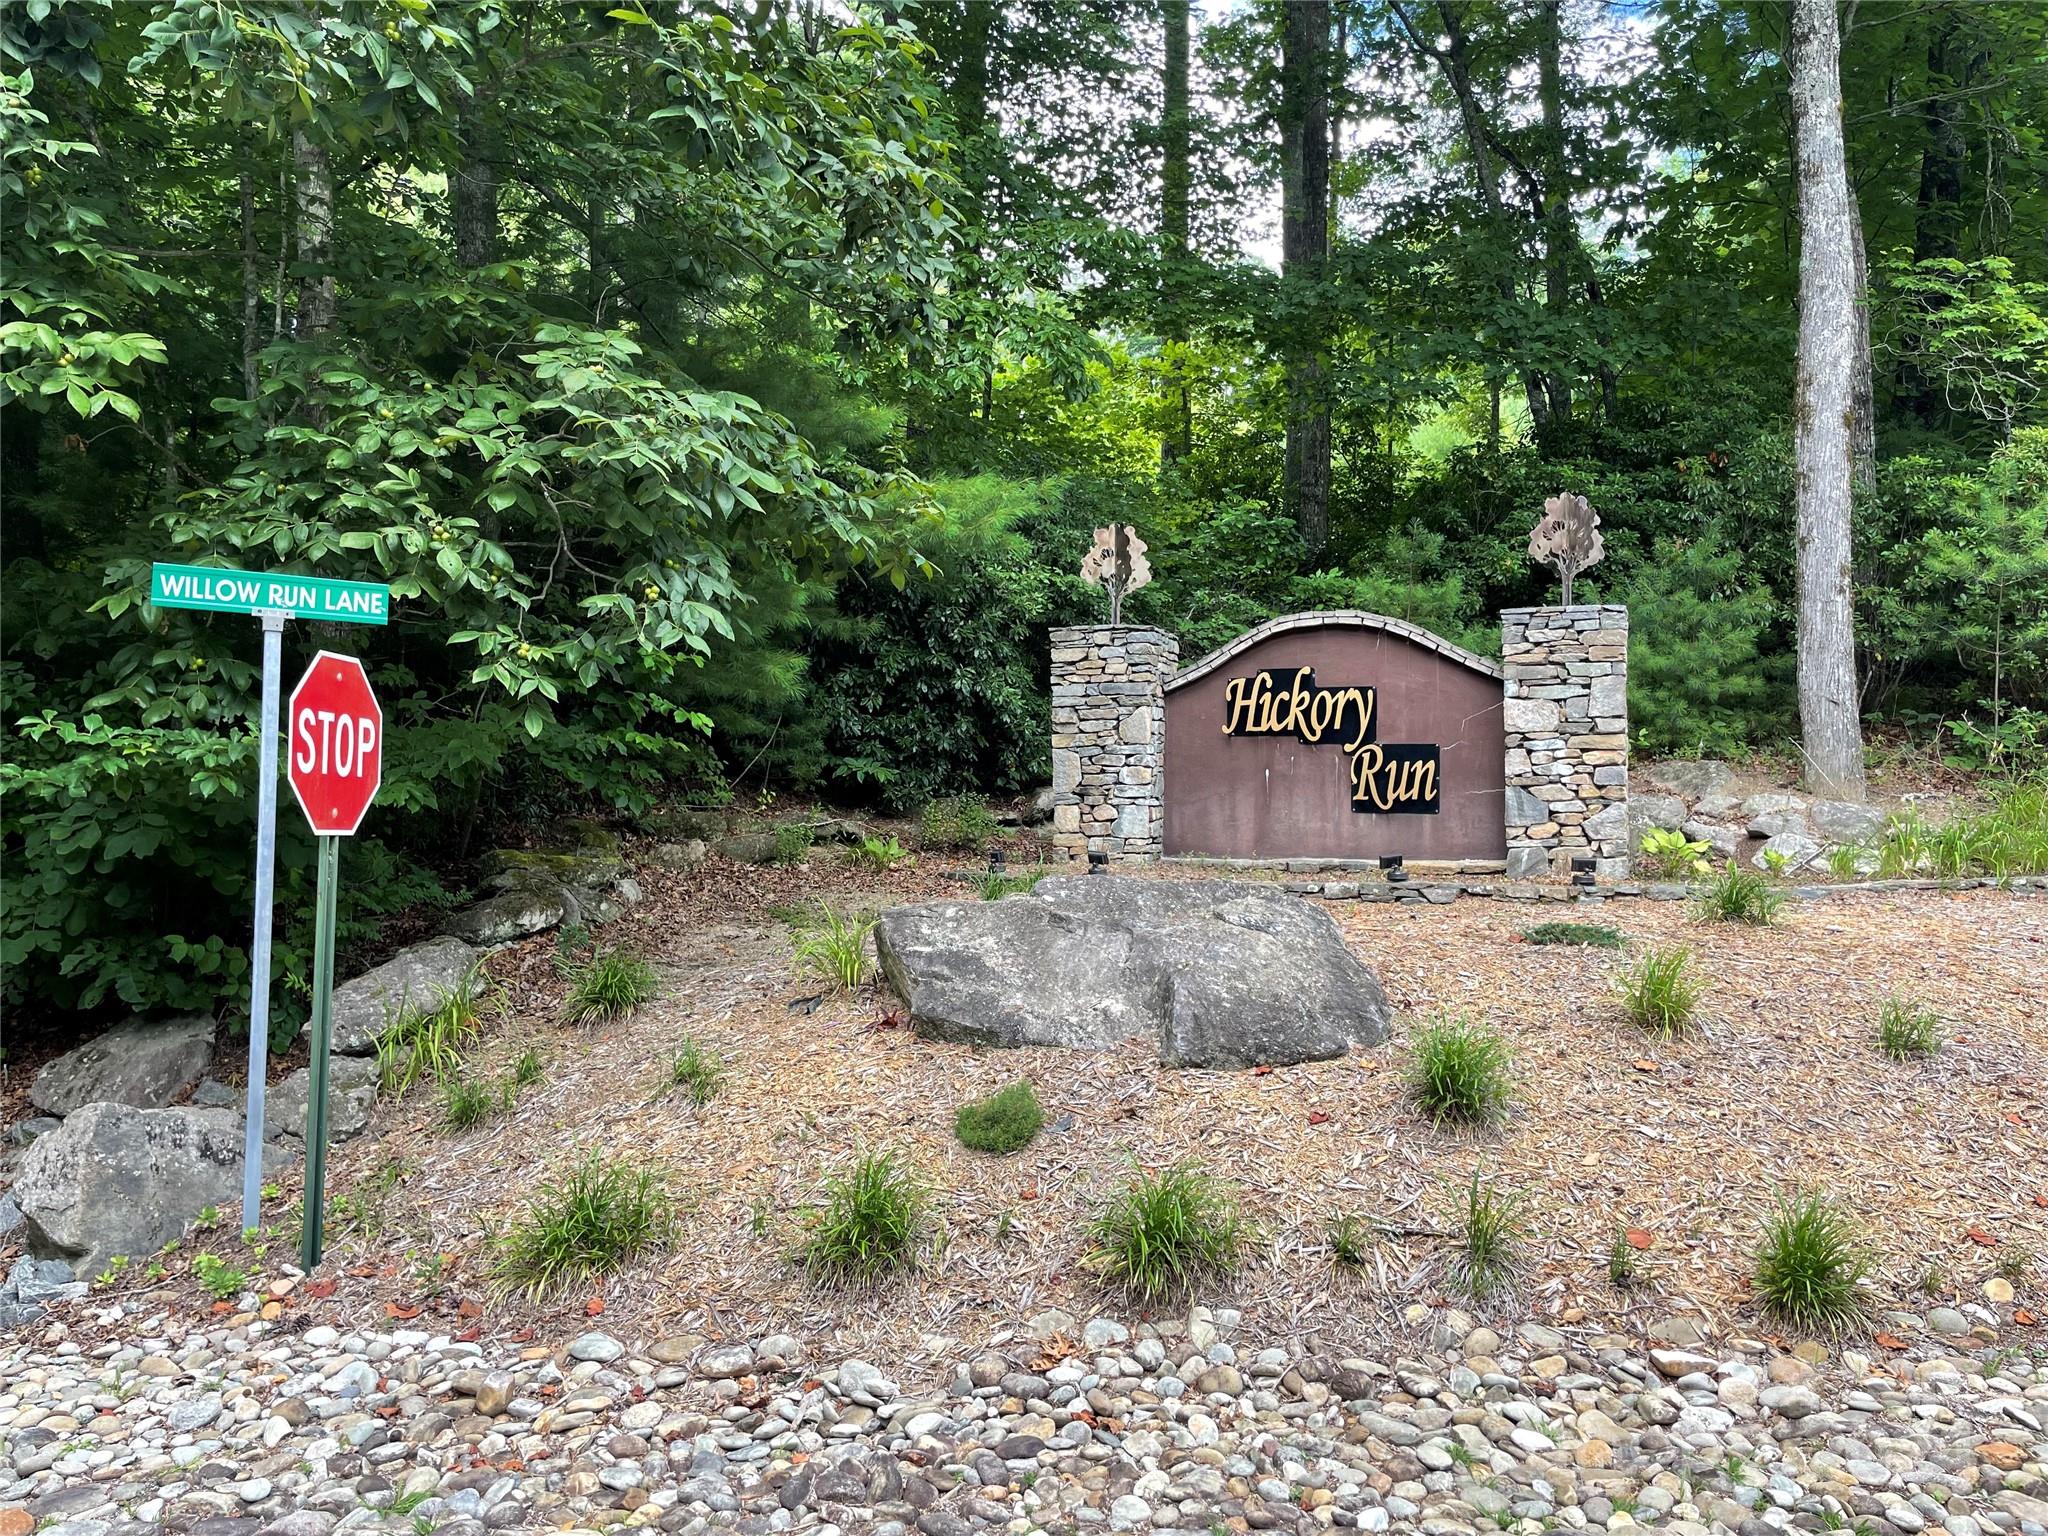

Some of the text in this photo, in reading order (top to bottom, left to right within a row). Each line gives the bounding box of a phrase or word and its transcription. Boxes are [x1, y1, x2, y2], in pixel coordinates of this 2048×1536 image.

[160, 574, 383, 614] WILLOW RUN LANE
[296, 707, 376, 778] STOP
[1221, 665, 1374, 753] Hickory
[1351, 744, 1438, 810] Run
